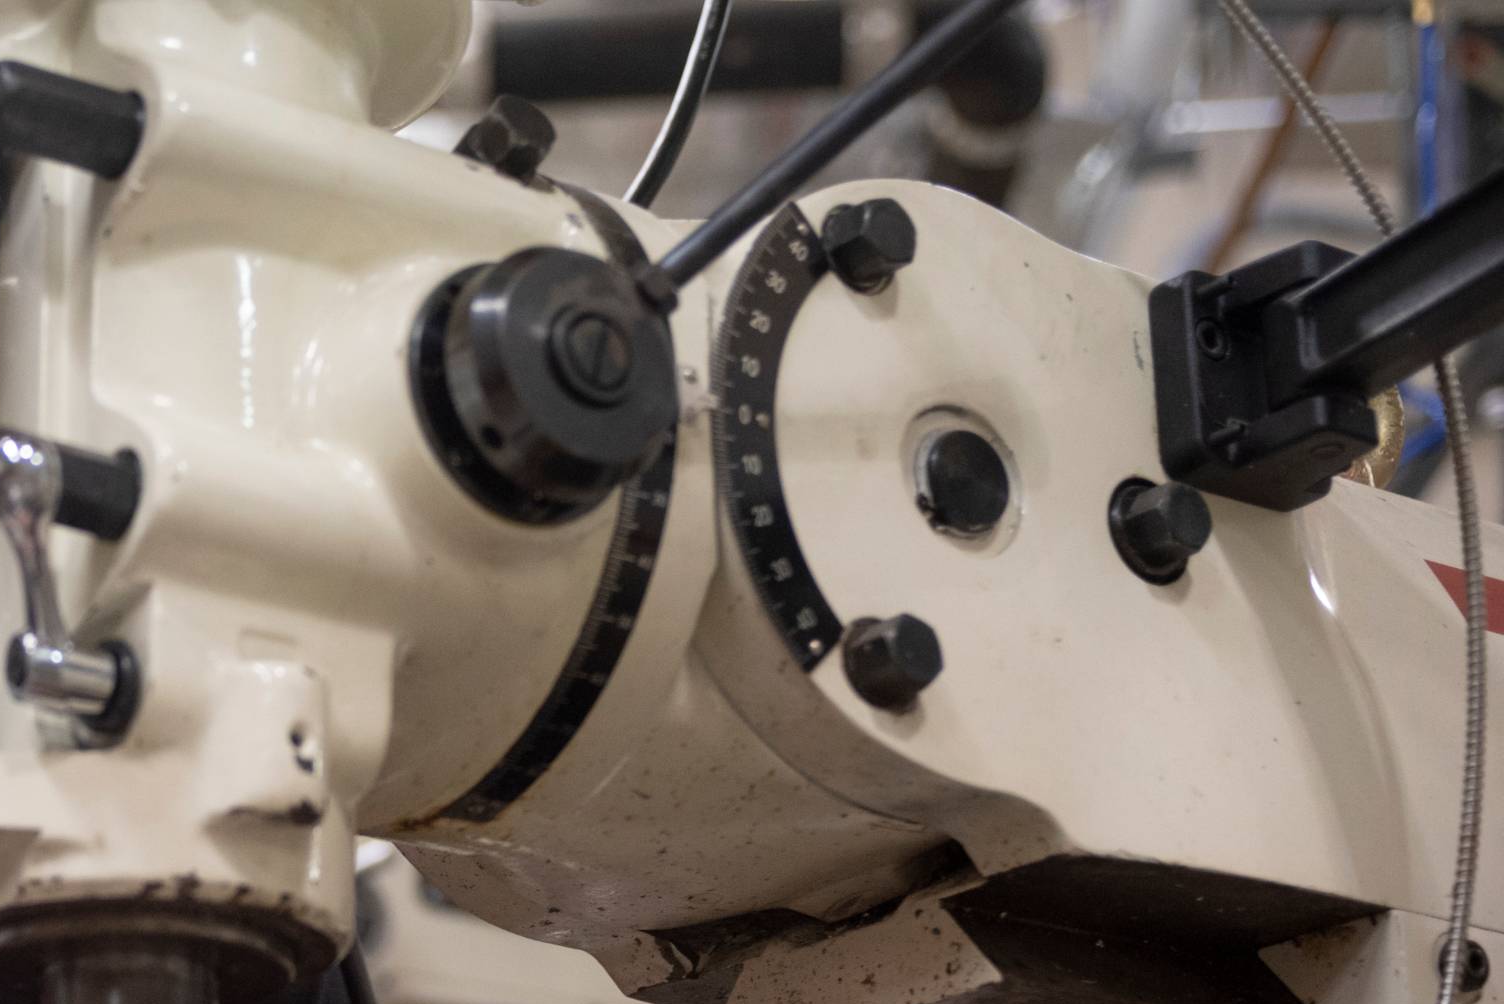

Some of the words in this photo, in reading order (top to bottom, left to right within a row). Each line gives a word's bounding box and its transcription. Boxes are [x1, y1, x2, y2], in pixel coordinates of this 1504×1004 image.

[766, 270, 786, 294] 30
[750, 310, 771, 334] 20
[741, 355, 760, 378] 10
